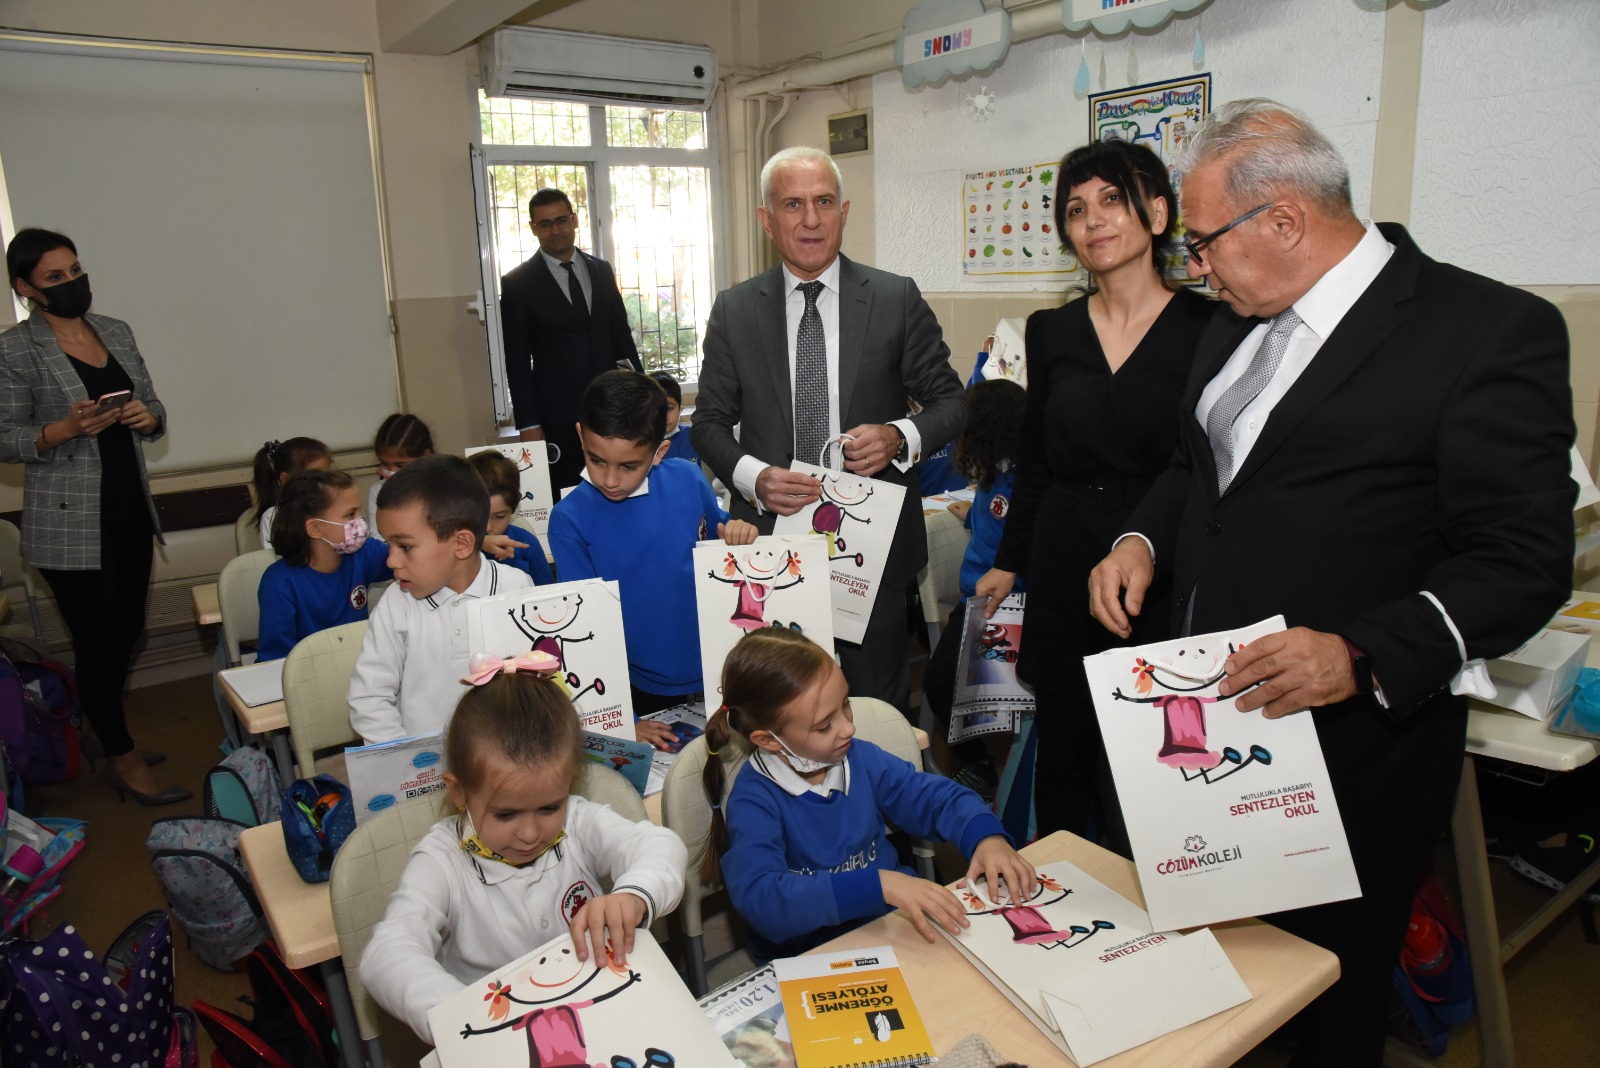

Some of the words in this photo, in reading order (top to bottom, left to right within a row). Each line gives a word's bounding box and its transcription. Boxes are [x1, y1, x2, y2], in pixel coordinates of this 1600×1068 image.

[924, 28, 972, 58] SNOWY
[1098, 102, 1134, 118] Days
[1162, 85, 1202, 107] Week
[965, 172, 984, 180] FRUITS
[985, 170, 997, 179] AND
[998, 166, 1032, 177] VEGETABLES
[830, 574, 870, 590] NTEZLEYEN
[848, 587, 866, 598] OKUL
[602, 719, 624, 731] OKUL
[1240, 787, 1282, 802] MUTLULUKLA
[1282, 782, 1313, 795] BAŞARIYI
[1229, 790, 1316, 817] SENTEZLEYEN
[1284, 803, 1320, 819] OKUL
[1098, 934, 1168, 963] SENTEZLEYEN
[739, 984, 776, 1007] 1,20
[811, 984, 888, 1004] ATÖLYESİ
[814, 995, 894, 1014] ÖĞRENME
